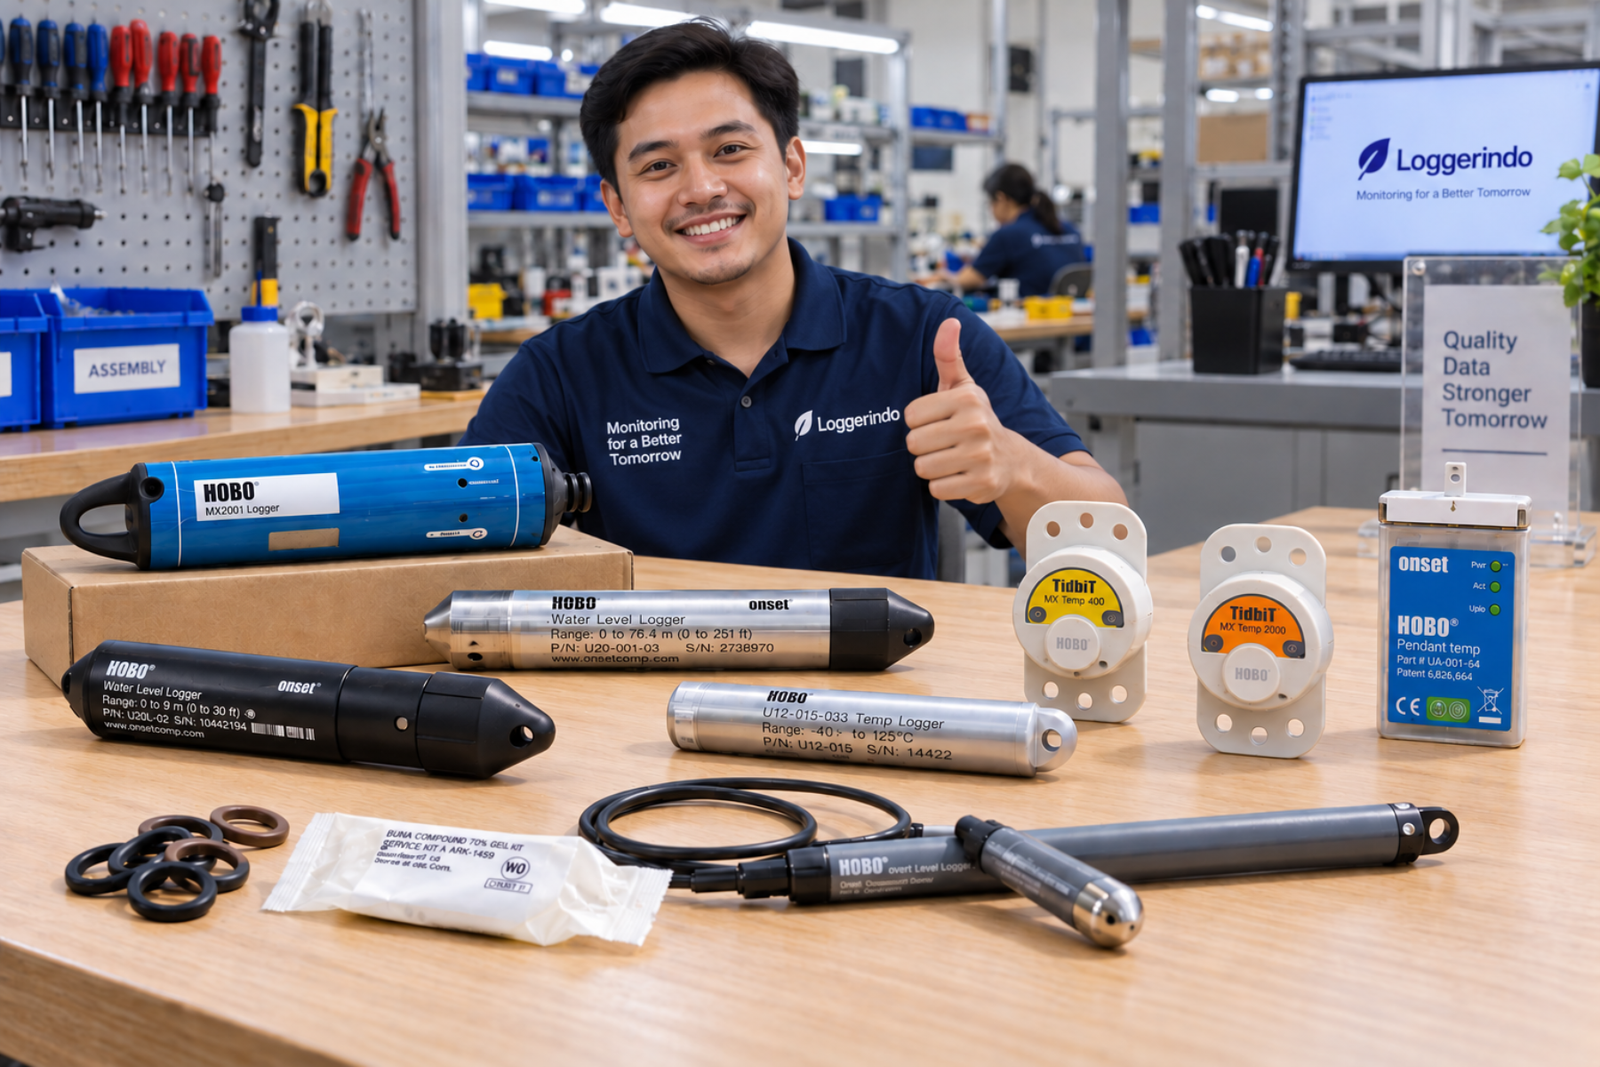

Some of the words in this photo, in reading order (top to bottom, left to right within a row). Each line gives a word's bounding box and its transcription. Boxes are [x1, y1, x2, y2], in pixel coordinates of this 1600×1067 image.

[1397, 145, 1533, 176] Loggerindo
[1356, 189, 1412, 201] Monitoring
[1415, 189, 1430, 199] for
[1432, 191, 1439, 199] a
[1442, 188, 1474, 198] Better
[1477, 187, 1531, 198] Tomorrow
[1443, 330, 1518, 354] Quality
[89, 359, 166, 378] ASSEMBLY
[1443, 356, 1490, 376] Data
[1443, 382, 1532, 408] Stronger
[607, 417, 680, 434] Monitoring
[817, 406, 900, 434] Loggerindo
[1441, 408, 1548, 429] Tomorrow
[607, 437, 627, 450] for
[630, 438, 638, 449] a
[641, 433, 682, 448] Better
[609, 450, 682, 466] Tomorrow
[205, 506, 244, 516] MX2001
[247, 504, 280, 515] Logger
[1398, 556, 1449, 573] onset
[1052, 578, 1096, 594] TidbiT
[1472, 582, 1486, 590] Act
[749, 599, 789, 610] onset
[1044, 595, 1059, 603] MX
[1062, 595, 1085, 606] Temp
[1088, 597, 1105, 606] 400
[551, 613, 590, 625] Water
[597, 614, 632, 625] Level
[639, 614, 686, 627] Logger
[1230, 606, 1277, 622] TidbiT
[551, 628, 594, 641] Range:
[599, 628, 607, 639] 0
[612, 629, 624, 639] to
[629, 629, 657, 639] 76.4
[661, 630, 673, 639] m
[677, 628, 690, 640] (0
[695, 629, 708, 639] to
[713, 628, 734, 639] 251
[739, 628, 752, 641] ft)
[1220, 622, 1236, 631] MX
[1238, 623, 1262, 635] Temp
[1264, 624, 1286, 635] 2000
[551, 643, 580, 653] P/N:
[585, 643, 660, 653] U20-001-03
[686, 643, 714, 653] S/N:
[720, 643, 774, 653] 2738970
[1056, 637, 1088, 651] HOBO
[1397, 638, 1447, 653] Pendant
[1450, 643, 1481, 658] temp
[552, 655, 680, 665] www.onsetcomp.com
[1397, 654, 1416, 665] Part
[1427, 657, 1480, 669] UA-001-64
[1235, 667, 1268, 682] HOBO
[1397, 667, 1425, 678] Patent
[1427, 670, 1473, 682] 6,826,664
[103, 680, 134, 693] Water
[136, 683, 164, 696] Level
[166, 687, 202, 701] Logger
[277, 680, 316, 694] onset
[102, 694, 138, 709] Range:
[140, 698, 147, 709] 0
[150, 699, 160, 710] to
[163, 700, 170, 710] 9
[173, 703, 183, 712] m
[186, 702, 197, 715] (0
[200, 704, 210, 715] to
[212, 705, 226, 717] 30
[228, 706, 240, 719] ft)
[103, 707, 125, 719] P/N:
[127, 710, 169, 724] U20L-02
[174, 715, 196, 727] S/N:
[200, 718, 247, 731] 10442194
[763, 707, 849, 723] U12-015-033
[855, 712, 893, 728] Temp
[898, 715, 945, 731] Logger
[104, 721, 205, 738] www.onsetcomp.com
[762, 721, 804, 737] Range:
[852, 728, 866, 740] to
[873, 730, 914, 743] 125°C
[763, 736, 793, 749] P/N:
[798, 740, 854, 753] U12-015
[867, 744, 899, 757] S/N:
[907, 748, 953, 760] 14422
[386, 829, 412, 839] BUNA
[415, 832, 467, 845] COMPOUND
[383, 839, 422, 851] SERVICE
[423, 843, 439, 852] KIT
[440, 845, 447, 853] A
[448, 846, 495, 860] ARK-1459
[914, 863, 939, 873] Level
[940, 862, 971, 873] Logger
